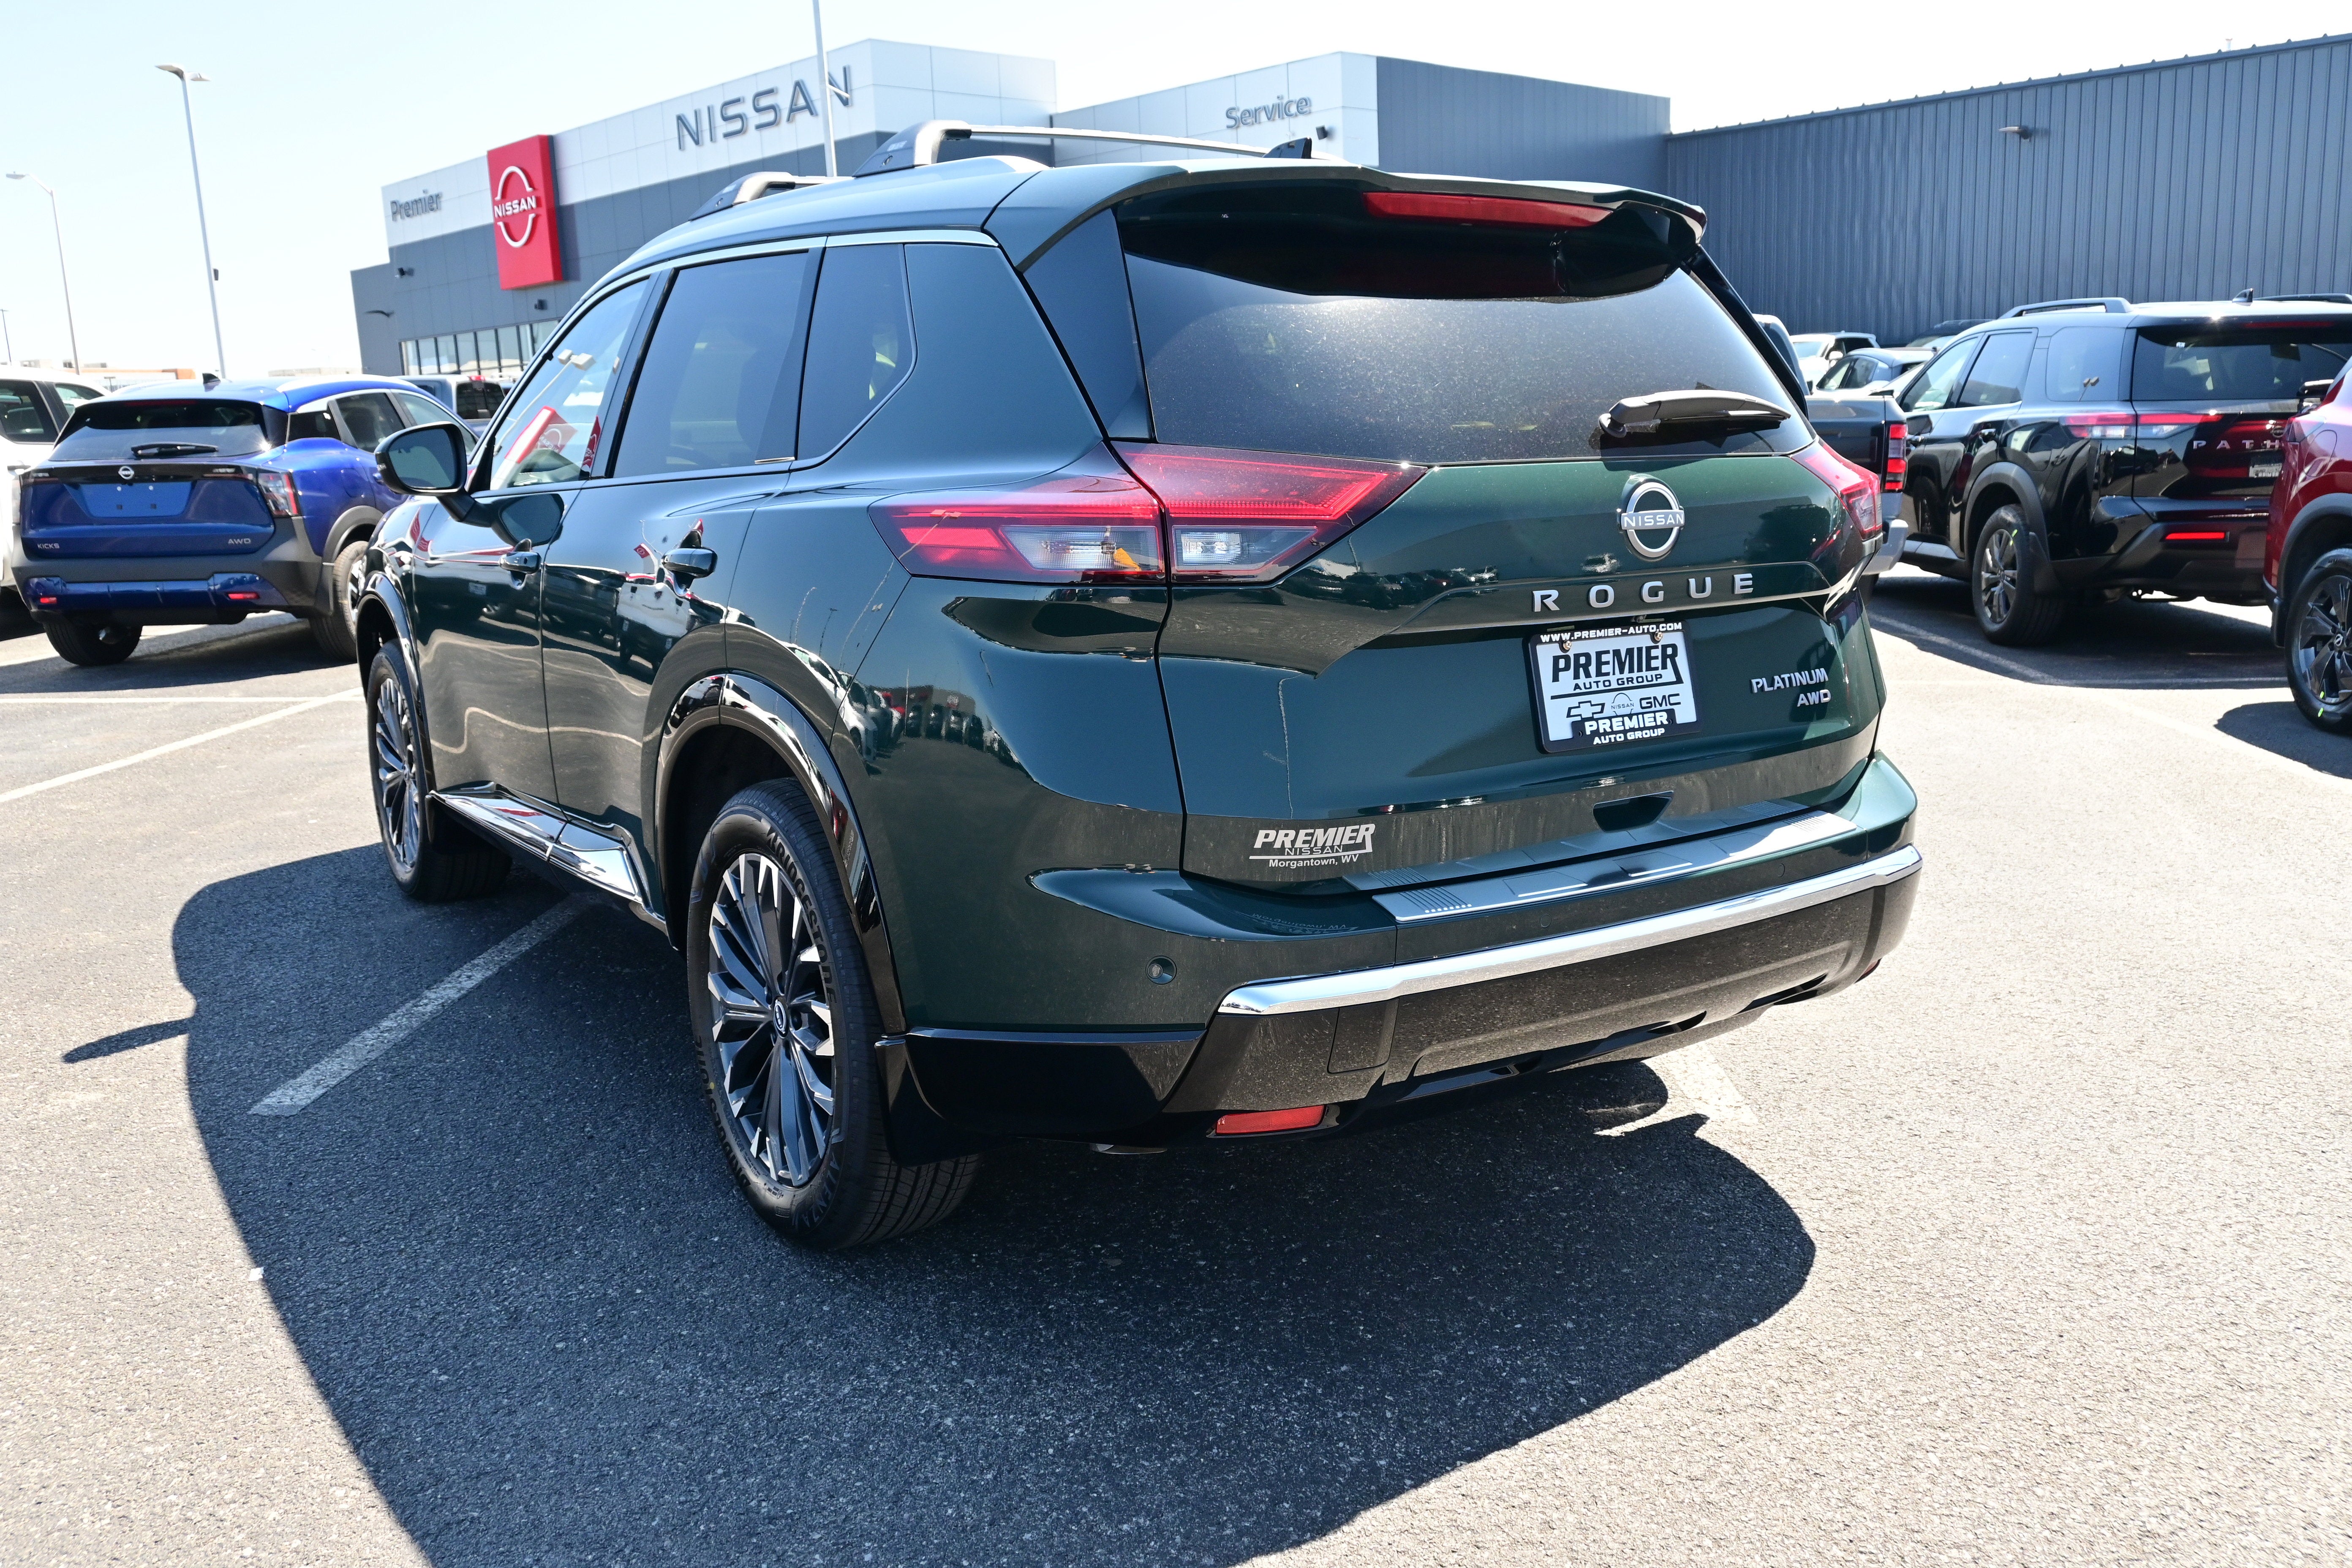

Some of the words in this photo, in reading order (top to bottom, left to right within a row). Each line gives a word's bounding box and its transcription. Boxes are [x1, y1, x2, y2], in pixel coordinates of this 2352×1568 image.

[676, 65, 852, 150] NISSAN
[1226, 95, 1311, 128] Service
[390, 189, 442, 221] Premier
[494, 195, 536, 218] NISSAN
[2193, 439, 2280, 450] PATH
[1624, 513, 1684, 527] NISSAN
[1532, 573, 1753, 612] ROGUE
[1540, 622, 1682, 643] WWW.PREMIER-AUTO.COM
[1552, 643, 1680, 683] PREMIER
[1573, 679, 1612, 691] AUTO
[1617, 673, 1663, 686] GROUP
[1750, 667, 1829, 694] PLATINUM
[1639, 693, 1681, 710] GMC
[1797, 689, 1831, 707] AWD
[1584, 711, 1669, 735] PREMIER
[1593, 733, 1625, 745] AUTO
[1627, 728, 1665, 740] GROUP
[1253, 823, 1376, 849] PREMIER
[1269, 857, 1338, 869] Morgantown,
[1341, 854, 1359, 863] WV
[1285, 845, 1343, 856] NISSAN
